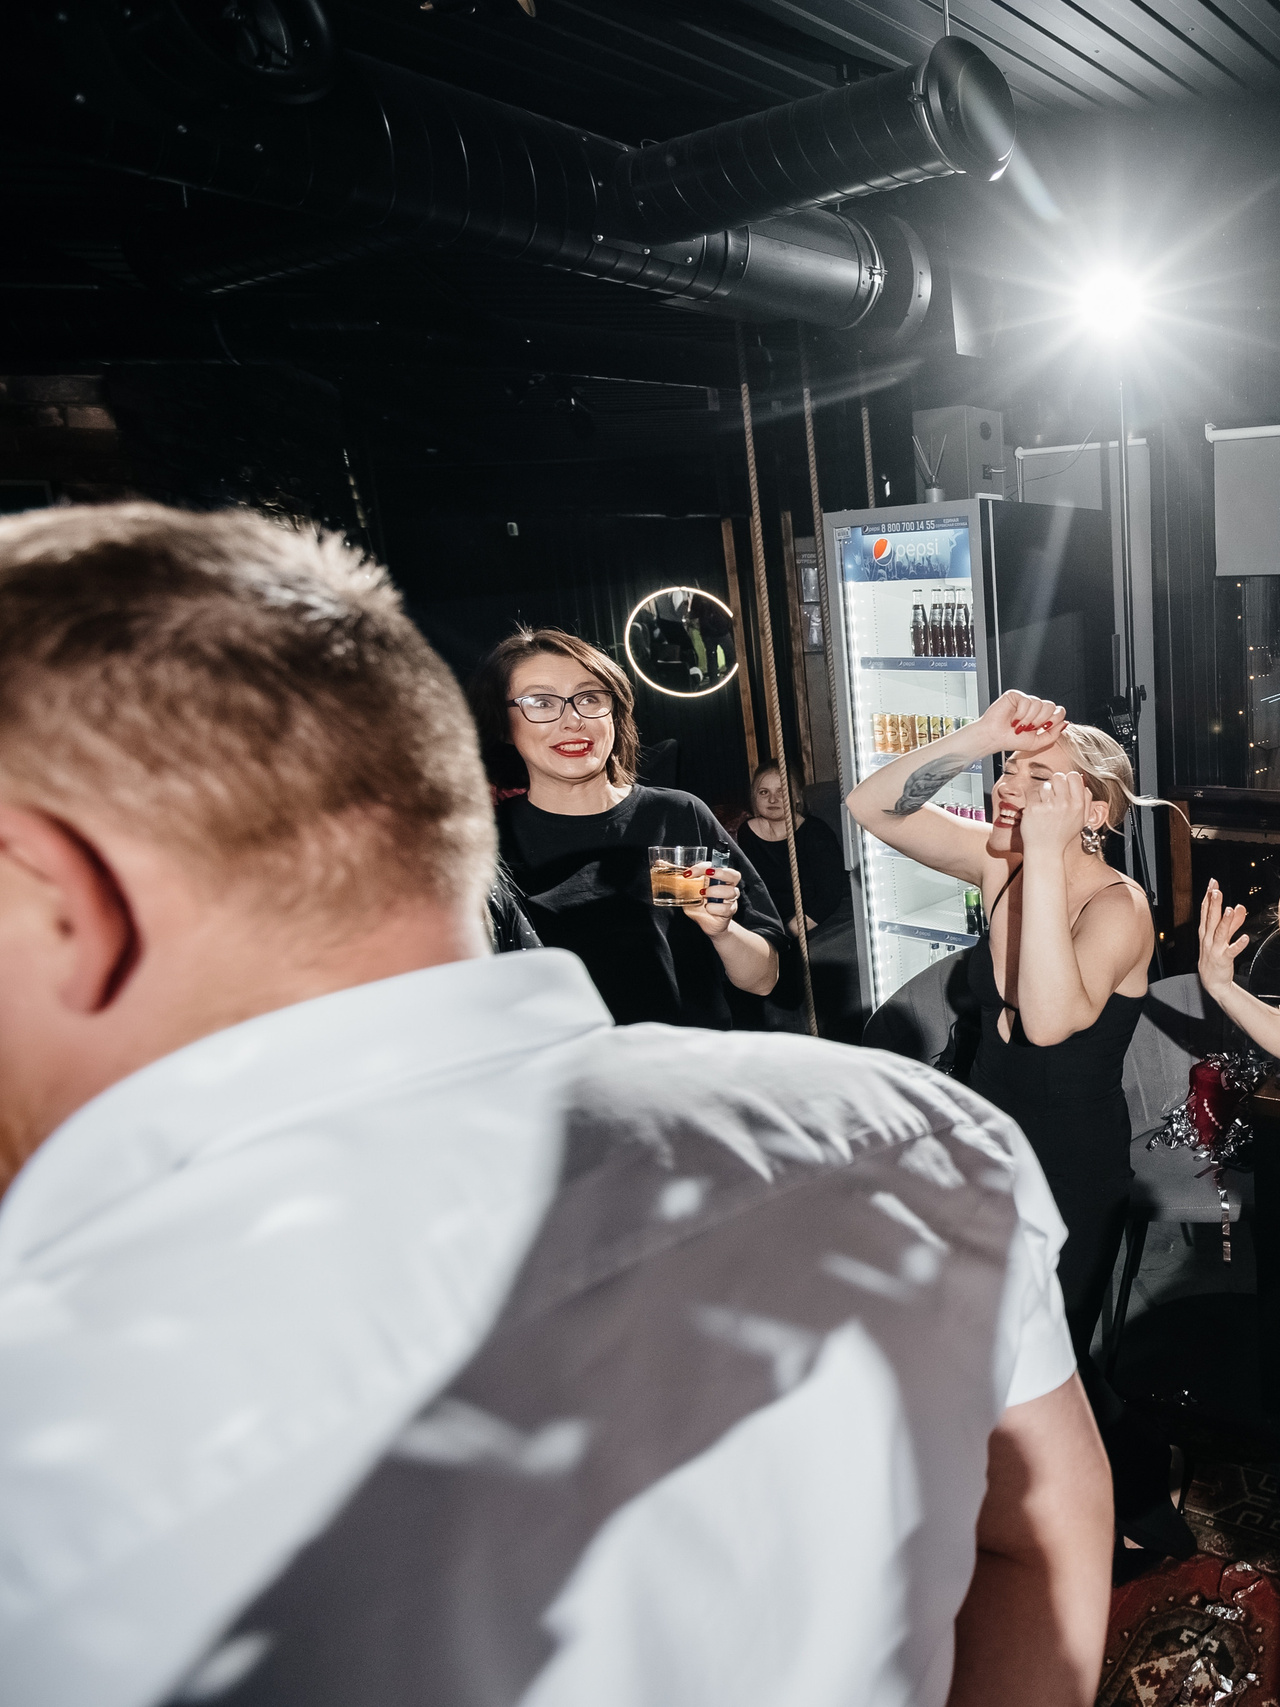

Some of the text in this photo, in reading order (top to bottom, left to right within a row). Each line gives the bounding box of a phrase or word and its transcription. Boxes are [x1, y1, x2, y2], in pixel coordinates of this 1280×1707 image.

[881, 520, 936, 533] 8 800 700 14 55
[896, 538, 939, 561] pepsi
[902, 660, 915, 668] pepsi
[935, 660, 948, 668] pepsi
